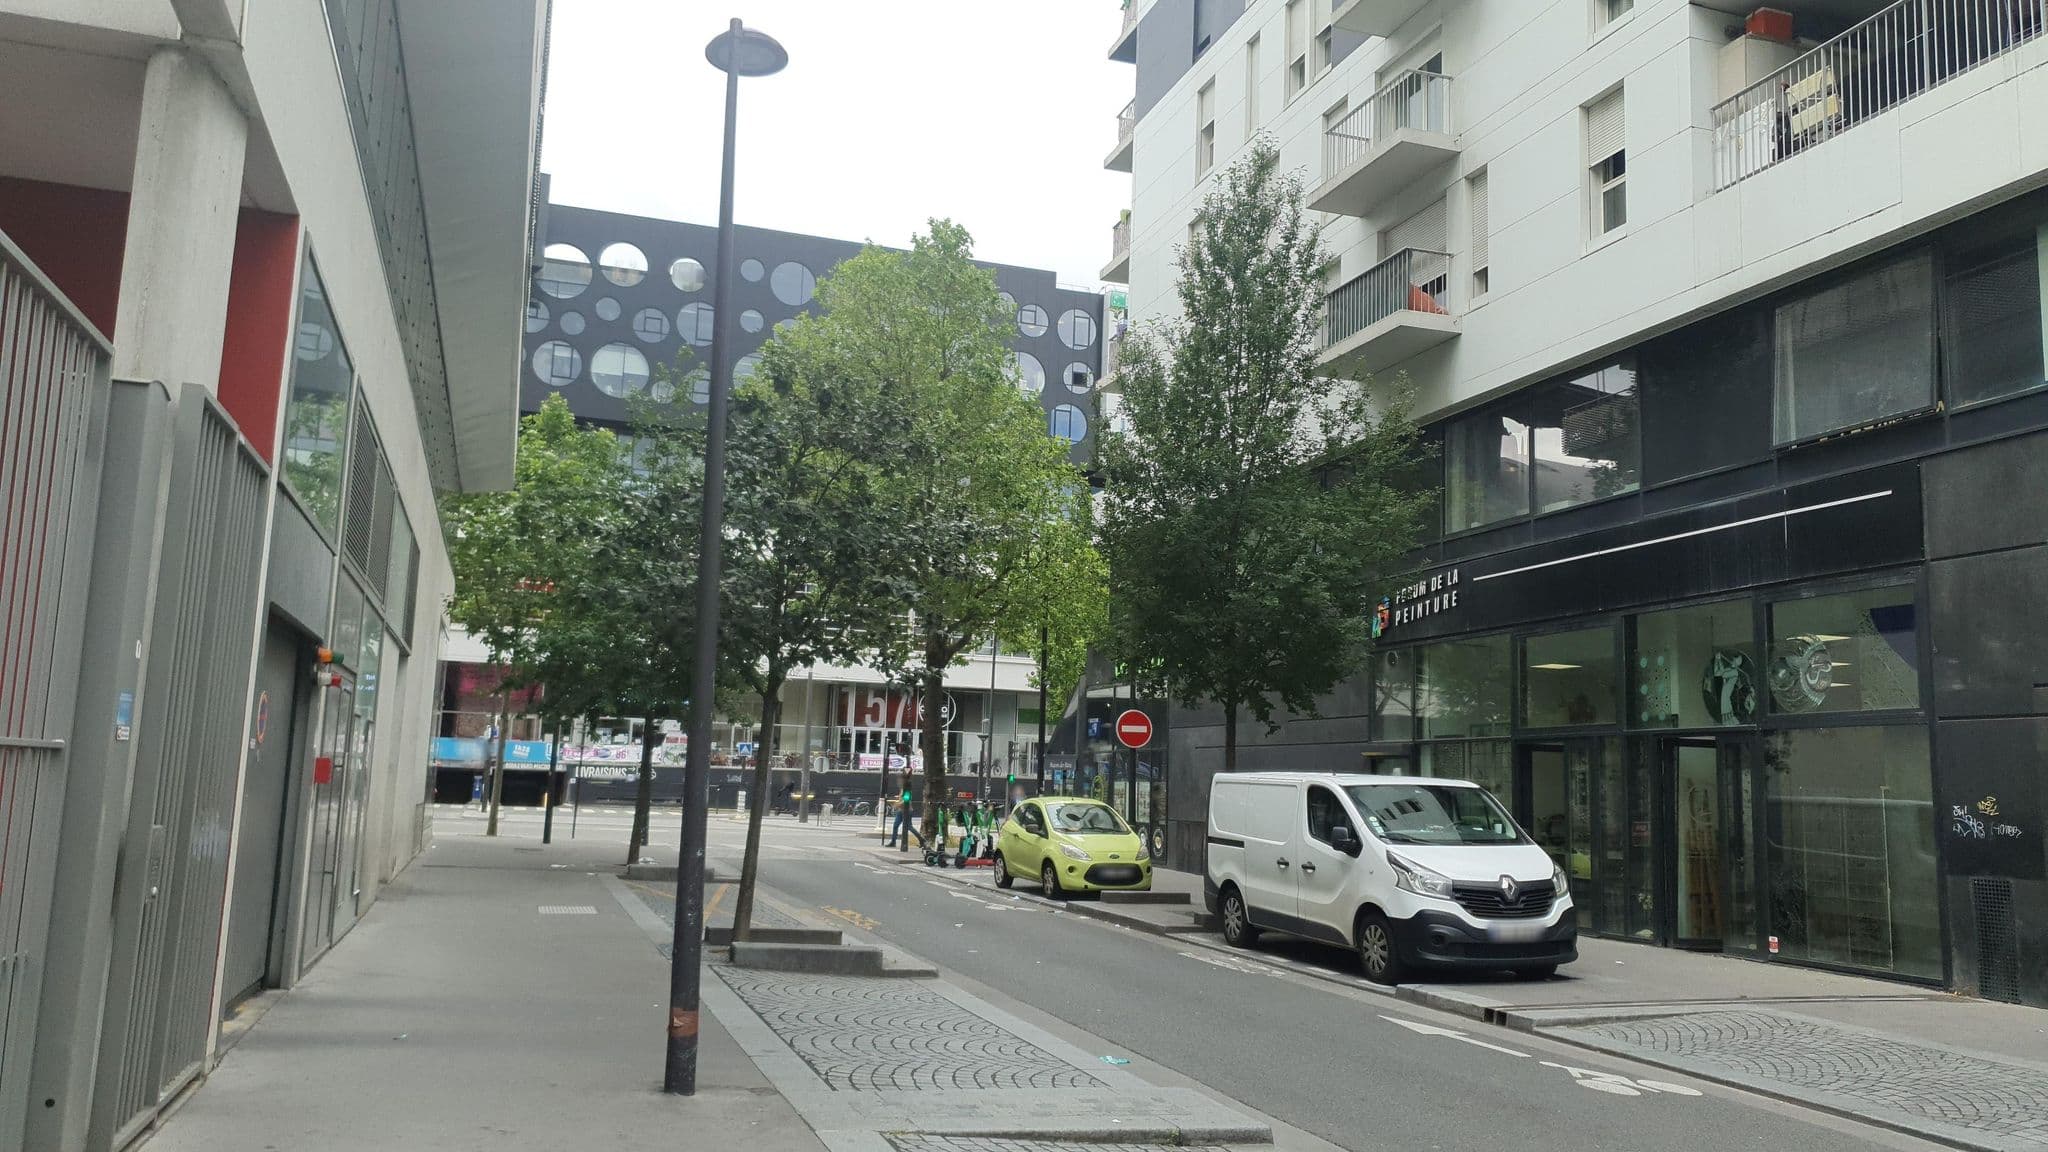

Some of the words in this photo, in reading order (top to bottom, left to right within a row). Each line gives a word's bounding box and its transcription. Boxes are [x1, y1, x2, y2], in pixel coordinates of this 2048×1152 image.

[1395, 581, 1427, 605] FORUM
[1431, 574, 1443, 592] DE
[1447, 568, 1459, 586] LA
[1395, 590, 1458, 626] PEINTURE
[841, 686, 913, 728] 157
[575, 766, 628, 779] LIVRAISONS
